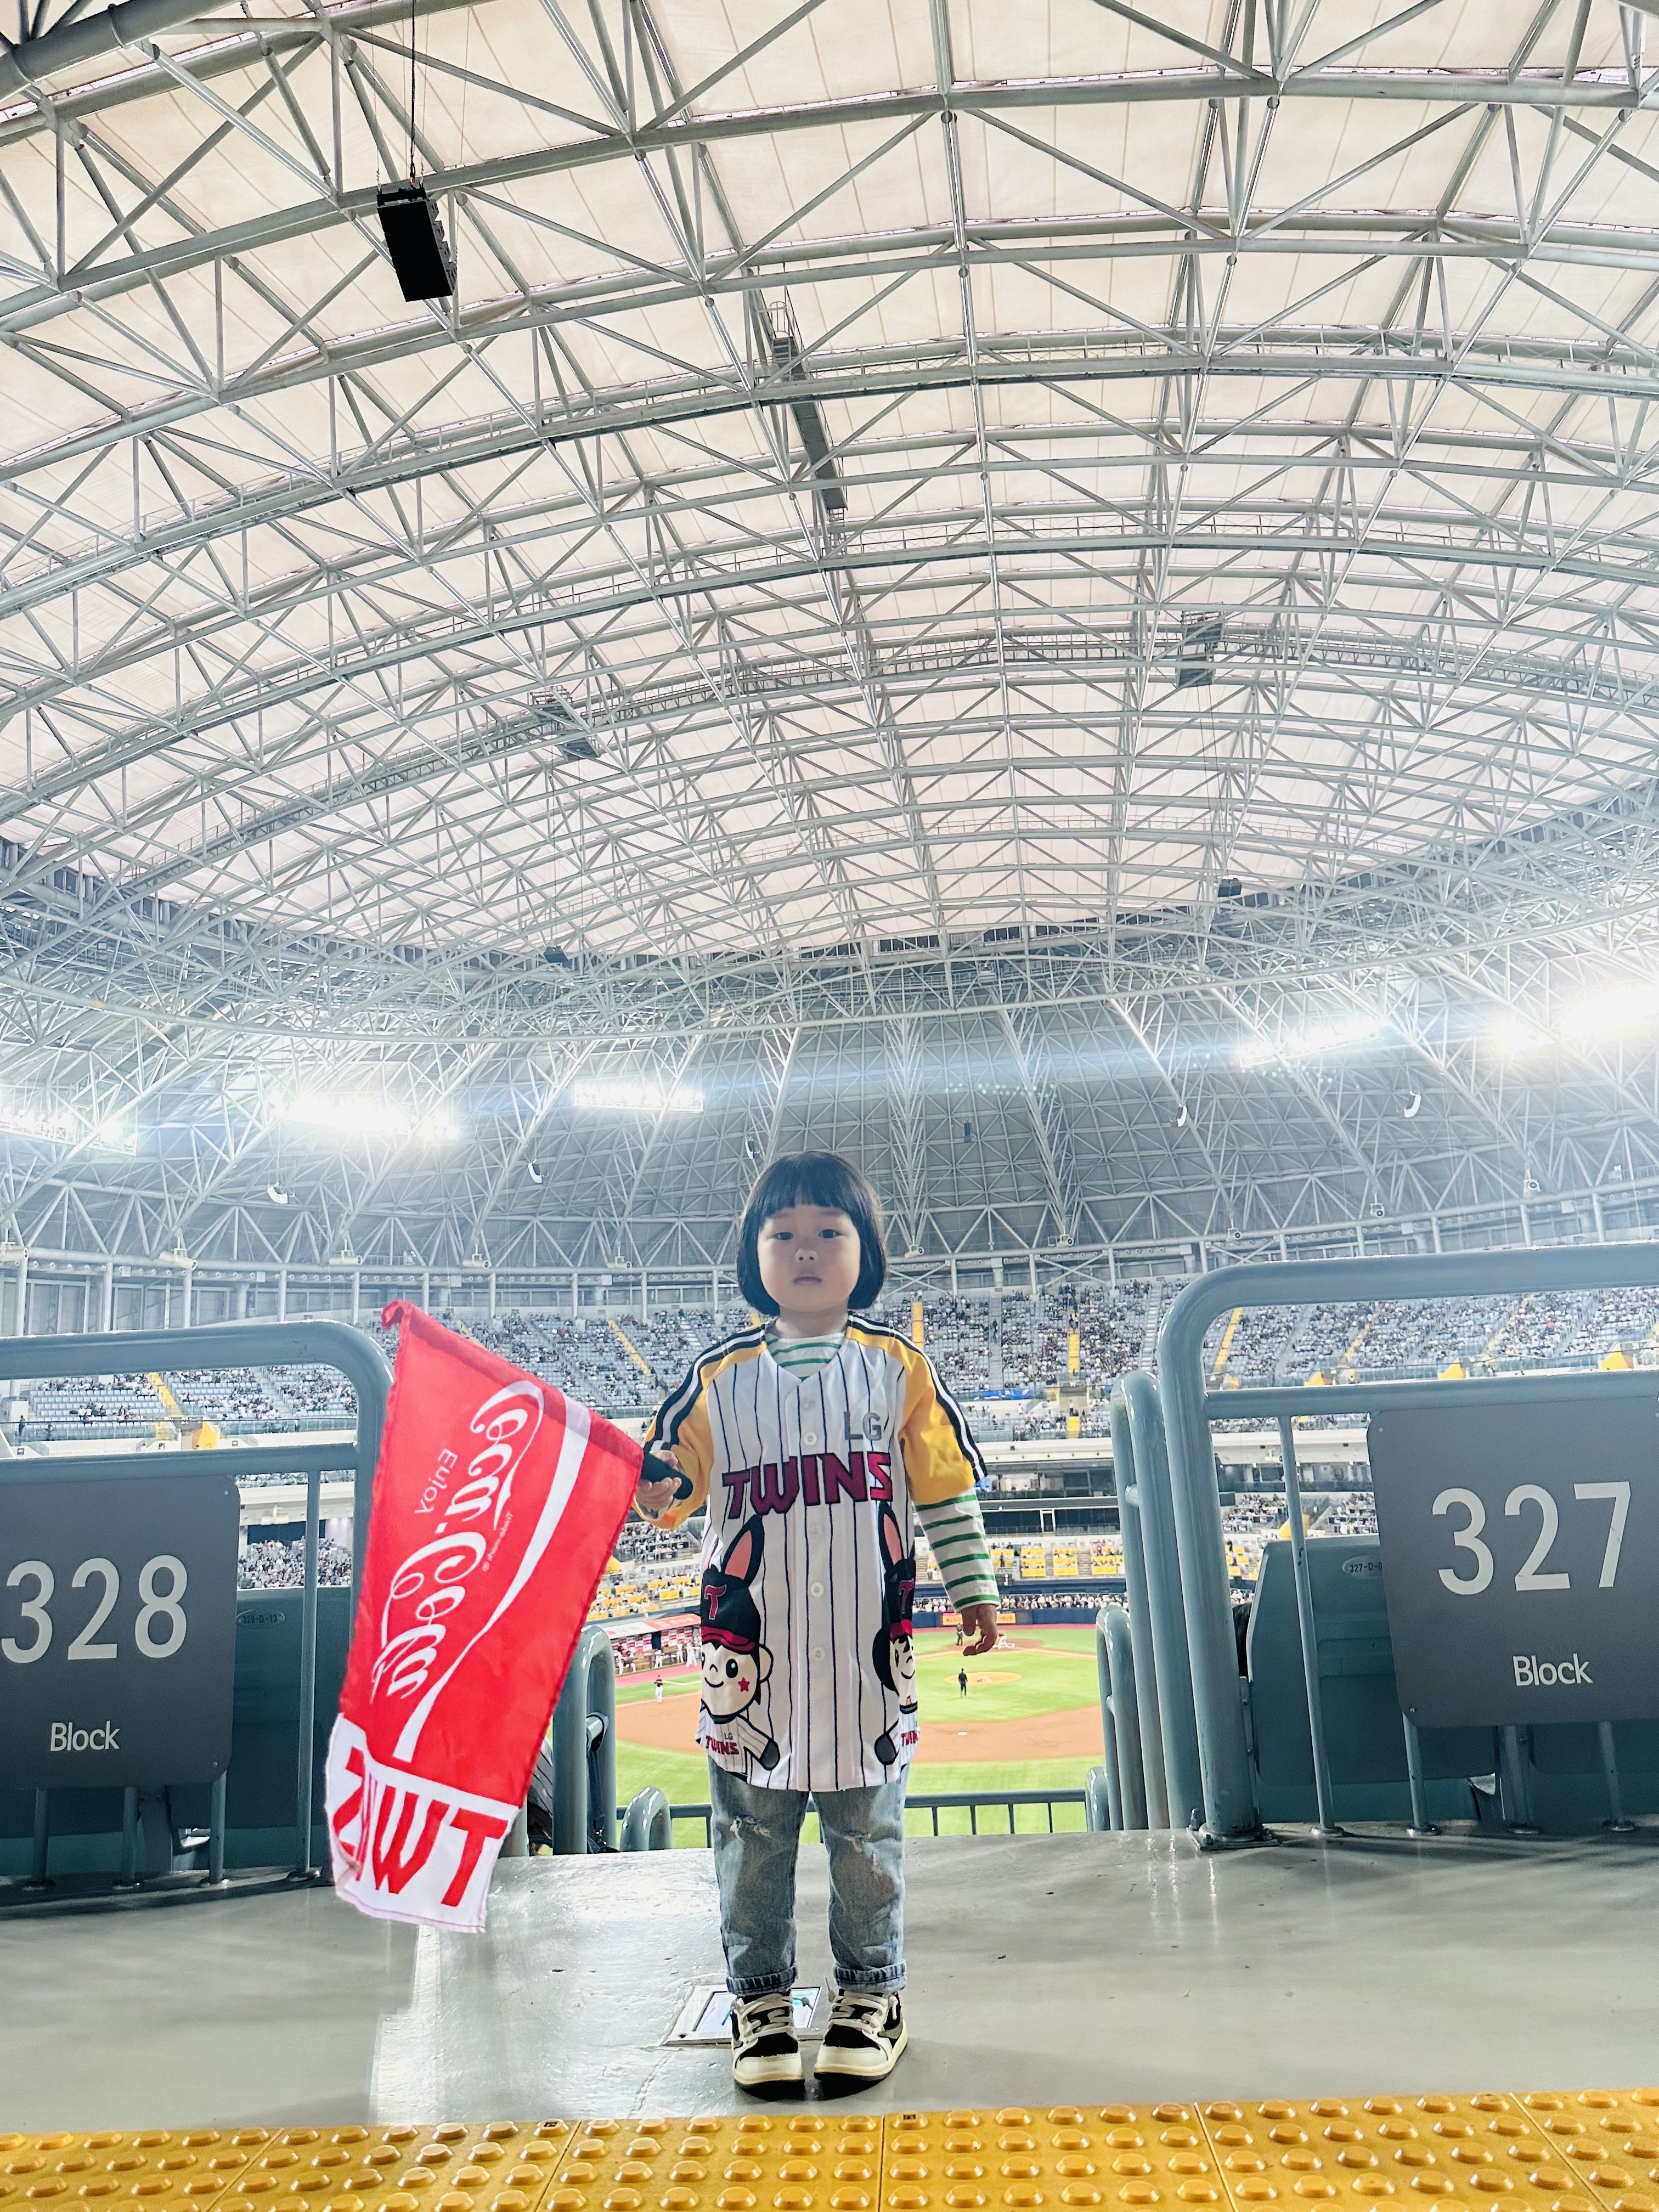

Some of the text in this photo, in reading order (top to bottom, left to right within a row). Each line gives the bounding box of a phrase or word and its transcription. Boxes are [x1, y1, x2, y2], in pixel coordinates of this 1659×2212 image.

[844, 1412, 882, 1441] LG
[722, 1451, 893, 1519] TWINS
[1432, 1481, 1631, 1595] 327
[1350, 1562, 1383, 1573] 327-D-0
[1, 1555, 188, 1663] 328
[704, 1584, 727, 1620] T
[1513, 1653, 1593, 1686] Block
[50, 1720, 120, 1751] Block
[706, 1735, 739, 1754] TWINS
